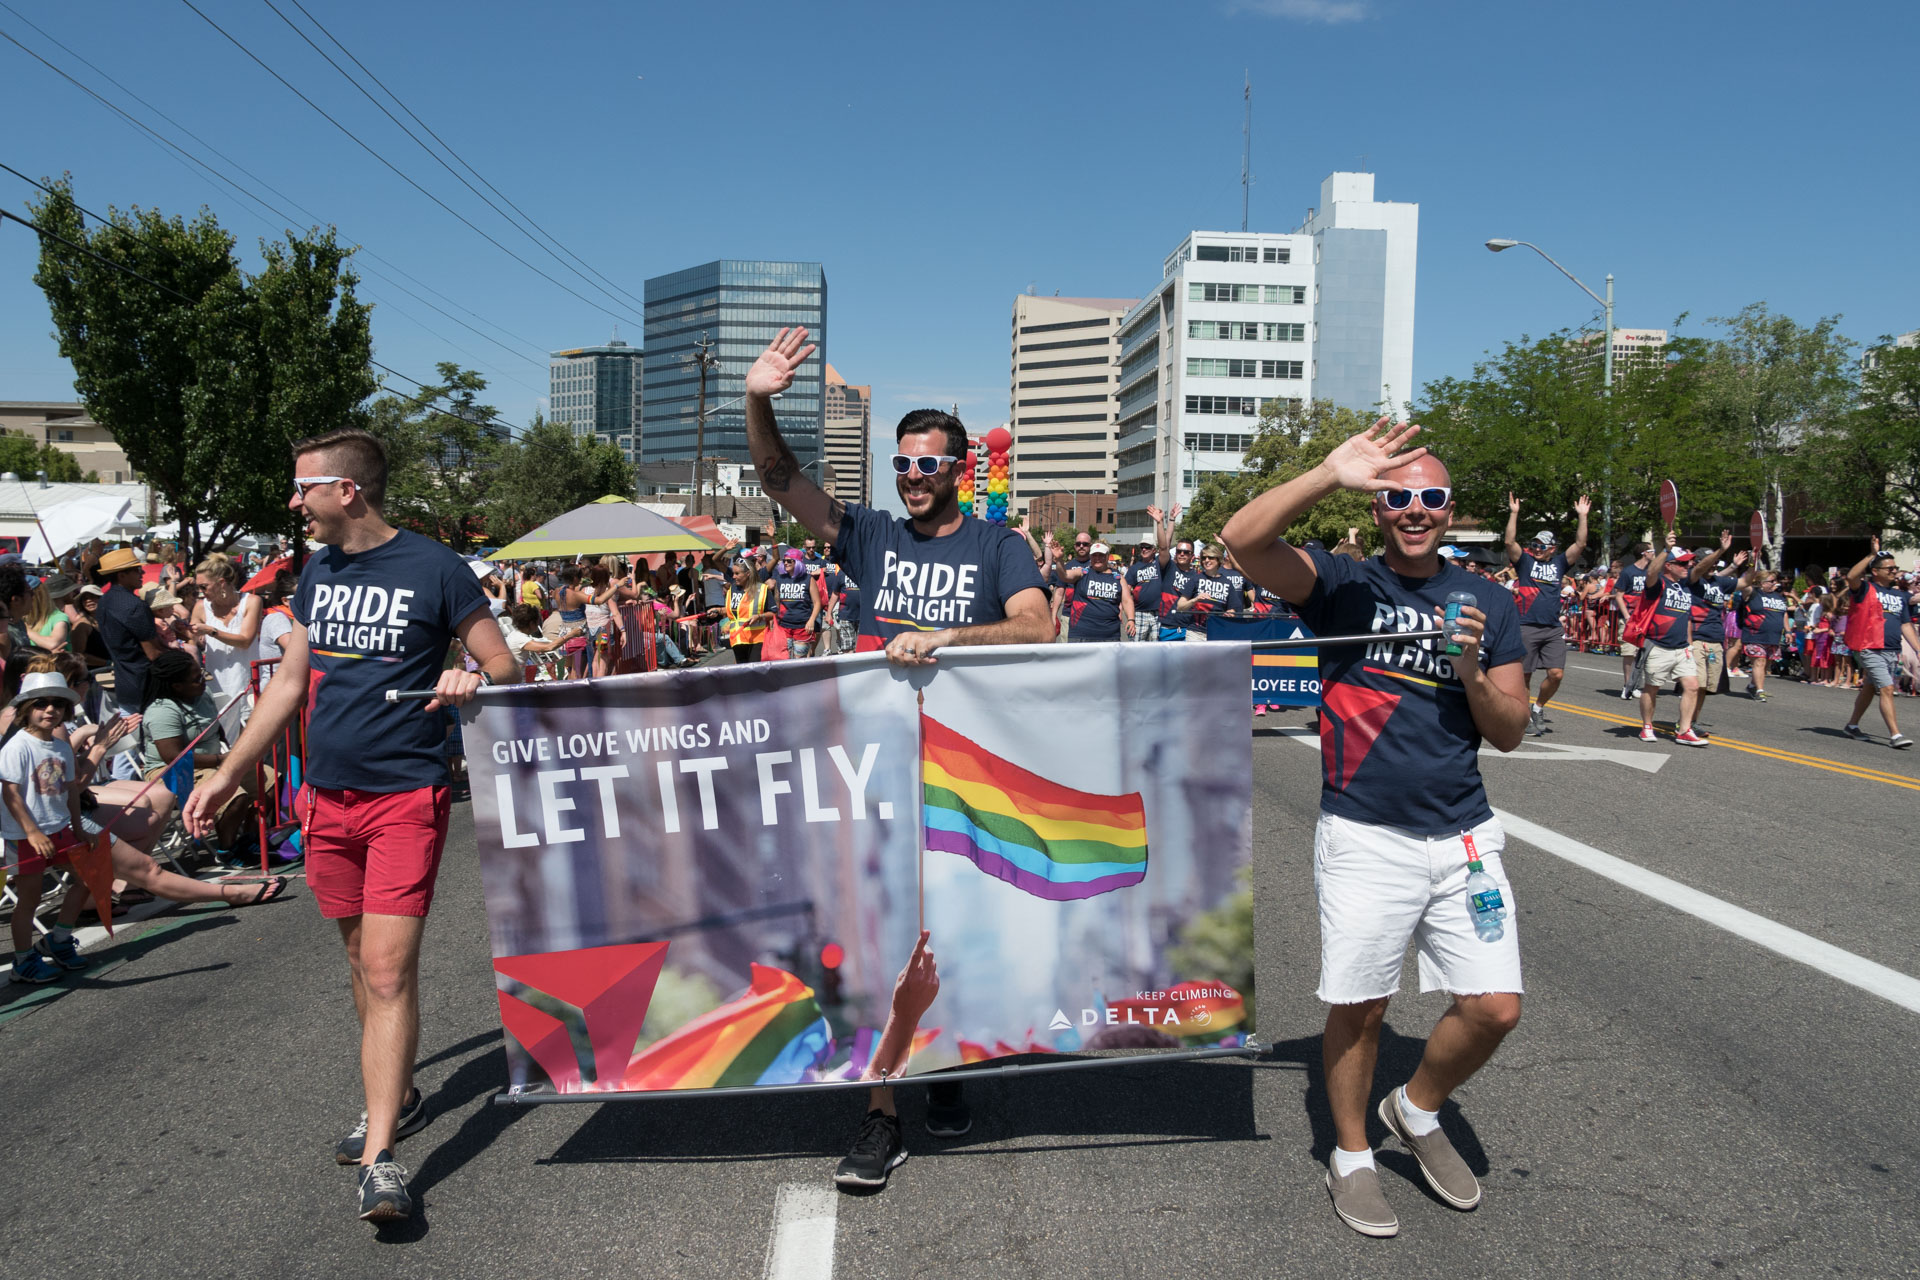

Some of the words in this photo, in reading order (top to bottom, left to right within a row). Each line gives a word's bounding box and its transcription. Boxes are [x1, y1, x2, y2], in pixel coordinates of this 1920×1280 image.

[882, 551, 978, 598] PRIDE
[1088, 580, 1118, 592] PRIDE
[780, 583, 807, 593] PRIDE
[1199, 579, 1230, 595] PRIDE
[310, 584, 415, 627] PRIDE
[874, 589, 894, 612] IN
[1665, 599, 1673, 607] IN
[307, 621, 321, 644] IN
[325, 622, 406, 652] FLIGHT.
[1365, 642, 1395, 664] IN
[1398, 645, 1459, 680] FLIG
[492, 737, 551, 764] GIVE
[557, 731, 620, 759] LOVE
[625, 723, 711, 752] WINGS
[718, 718, 770, 746] AND
[495, 764, 630, 849] LET
[656, 756, 729, 833] IT
[755, 743, 894, 826] FLY.
[1136, 990, 1166, 1001] KEEP
[1170, 988, 1233, 1001] CLIMBING
[1081, 1007, 1181, 1026] DELTA
